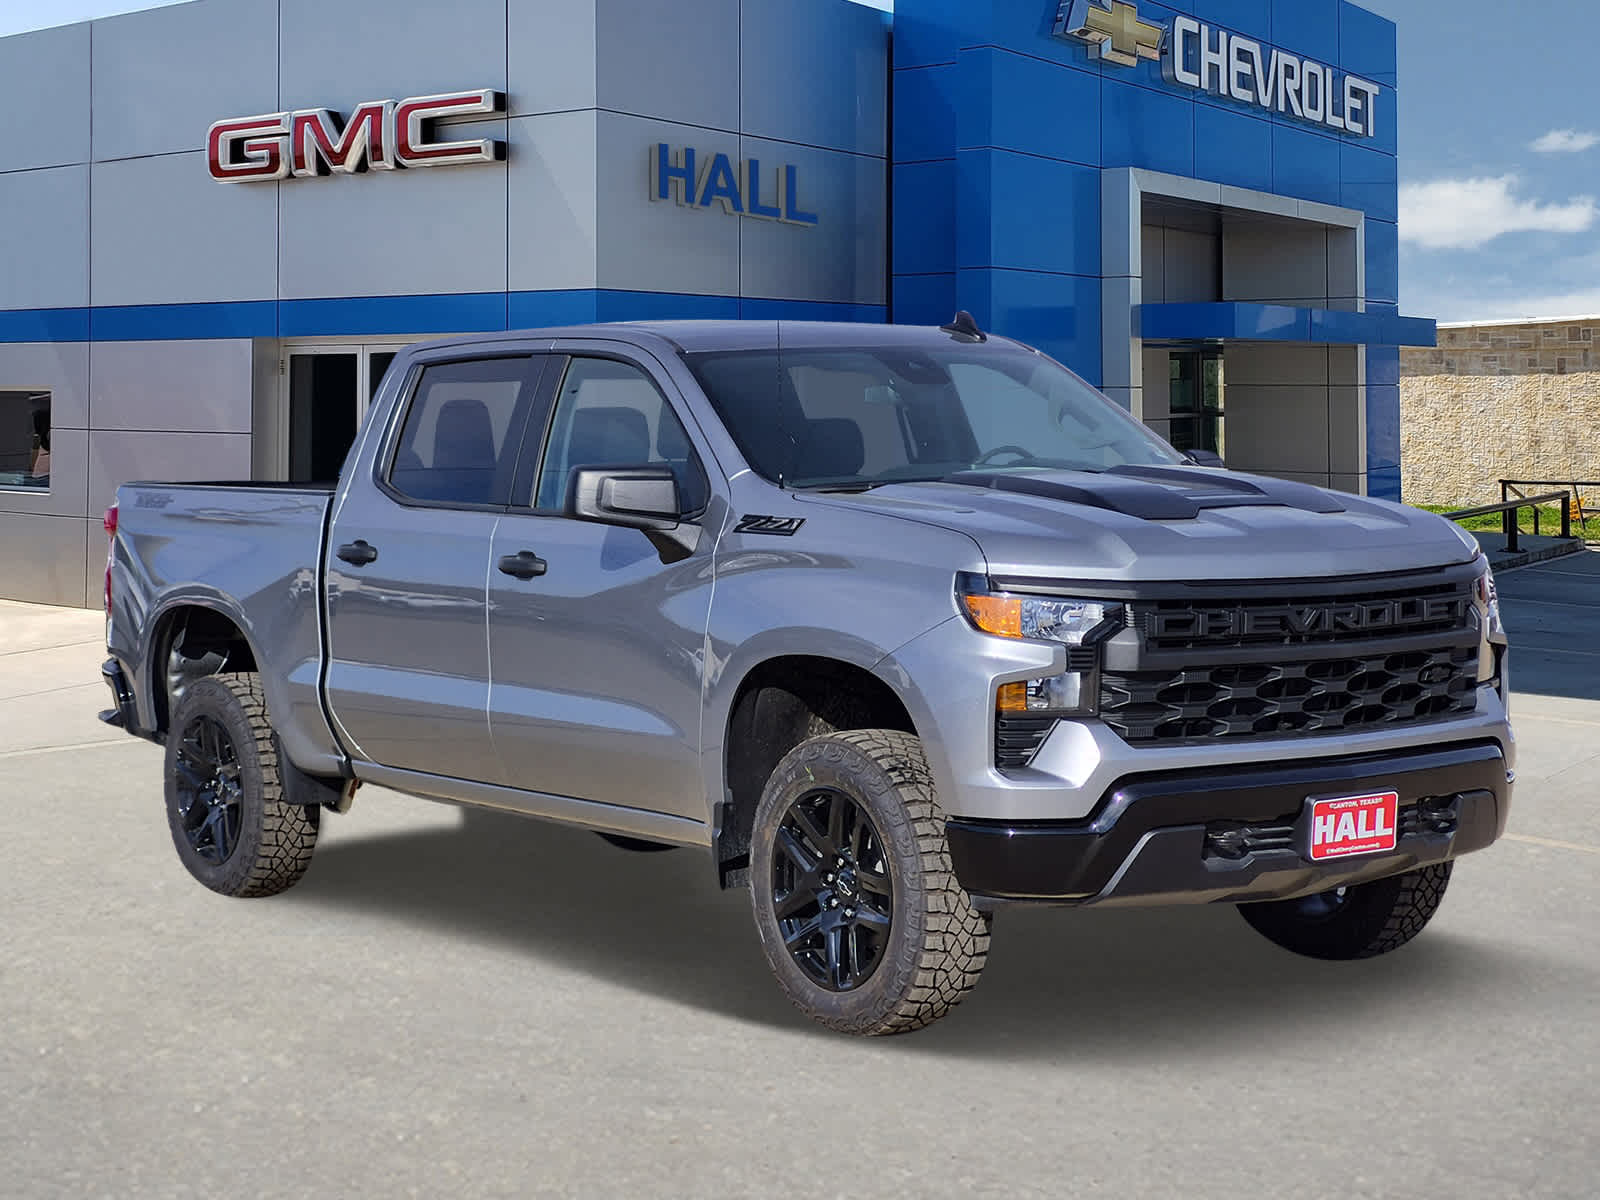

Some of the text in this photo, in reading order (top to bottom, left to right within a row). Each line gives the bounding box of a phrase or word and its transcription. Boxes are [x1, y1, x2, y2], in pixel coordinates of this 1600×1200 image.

[1174, 15, 1380, 137] CHEVROLET
[206, 88, 506, 184] GMC
[650, 142, 818, 226] HALL
[1145, 597, 1475, 640] CHEVROLET
[1314, 807, 1393, 845] HALL
